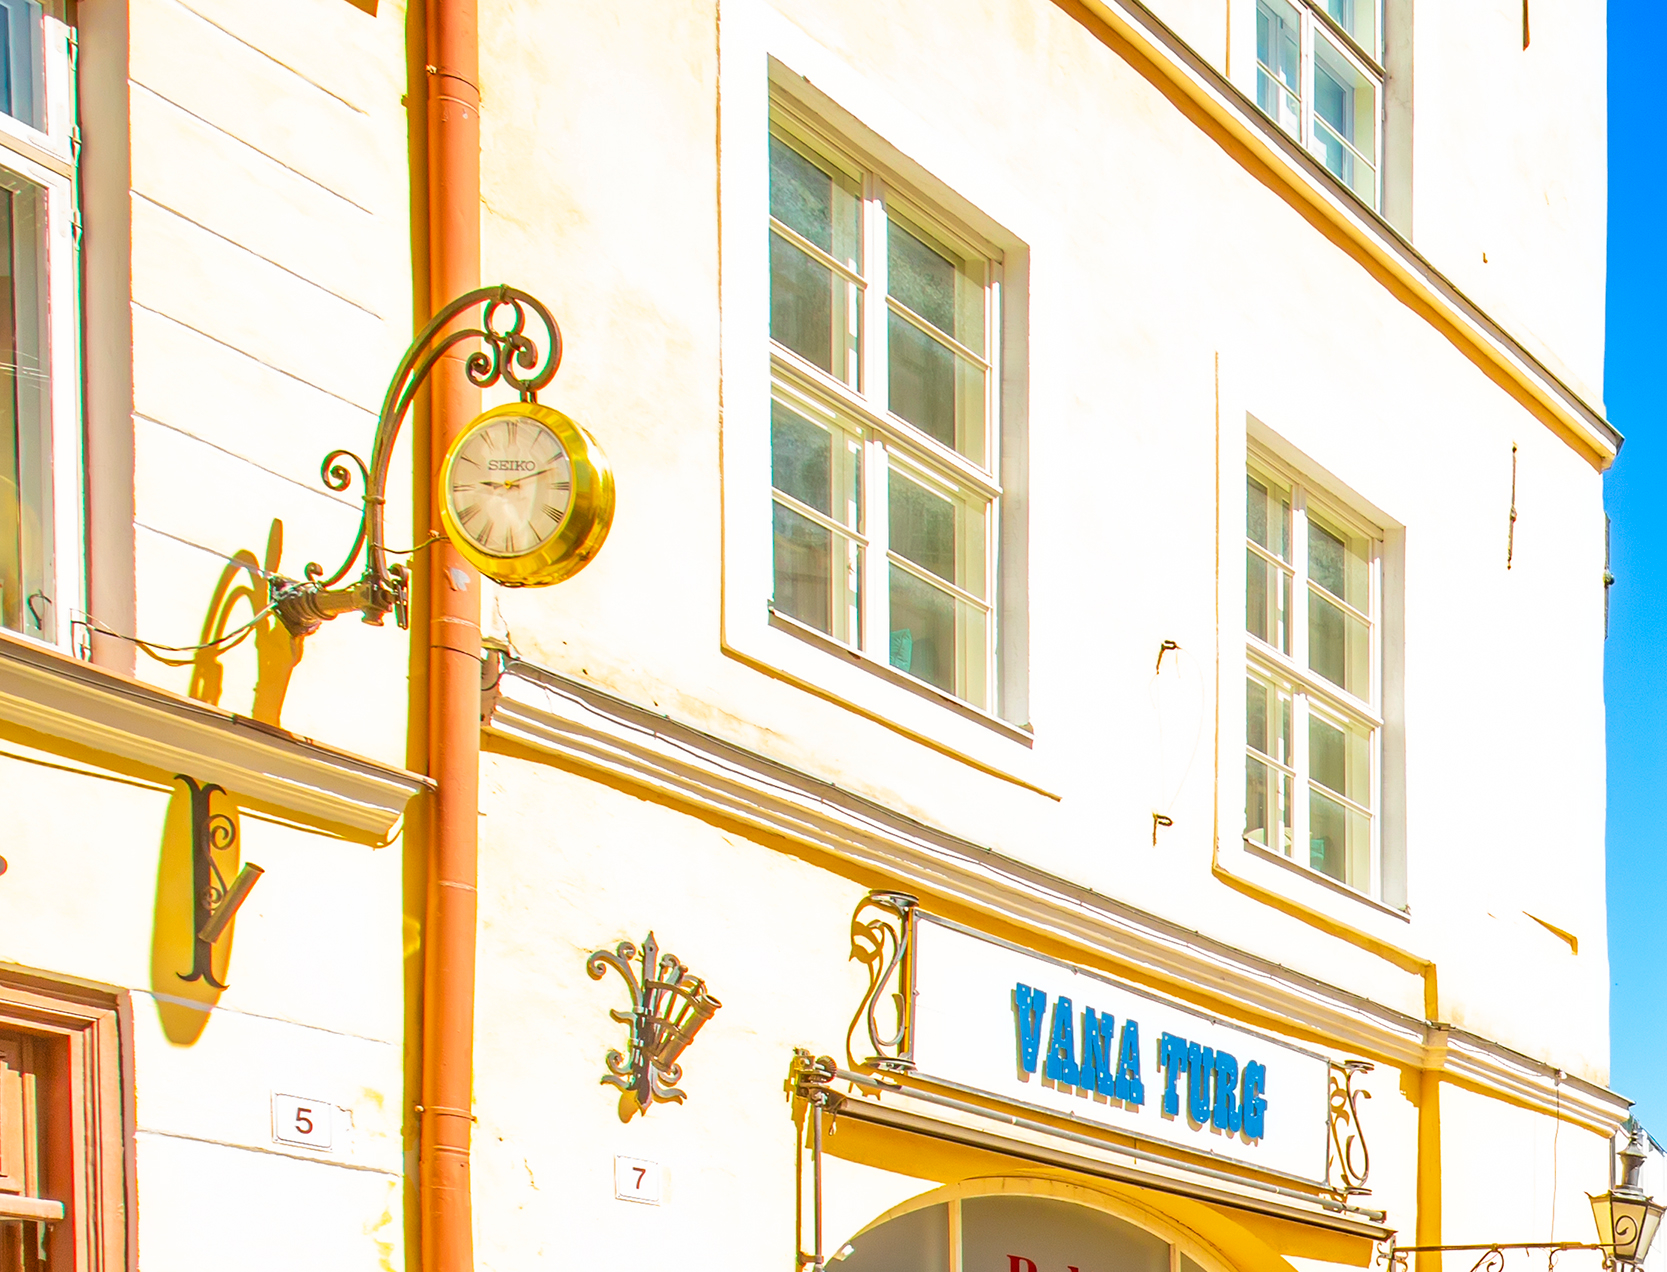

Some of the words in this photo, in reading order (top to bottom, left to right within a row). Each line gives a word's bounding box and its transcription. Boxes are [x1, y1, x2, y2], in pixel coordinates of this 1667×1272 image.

[488, 460, 536, 471] SEIKO
[1013, 981, 1145, 1109] VANA
[1160, 1031, 1268, 1140] TURG
[295, 1107, 313, 1134] 5
[632, 1167, 646, 1190] 7
